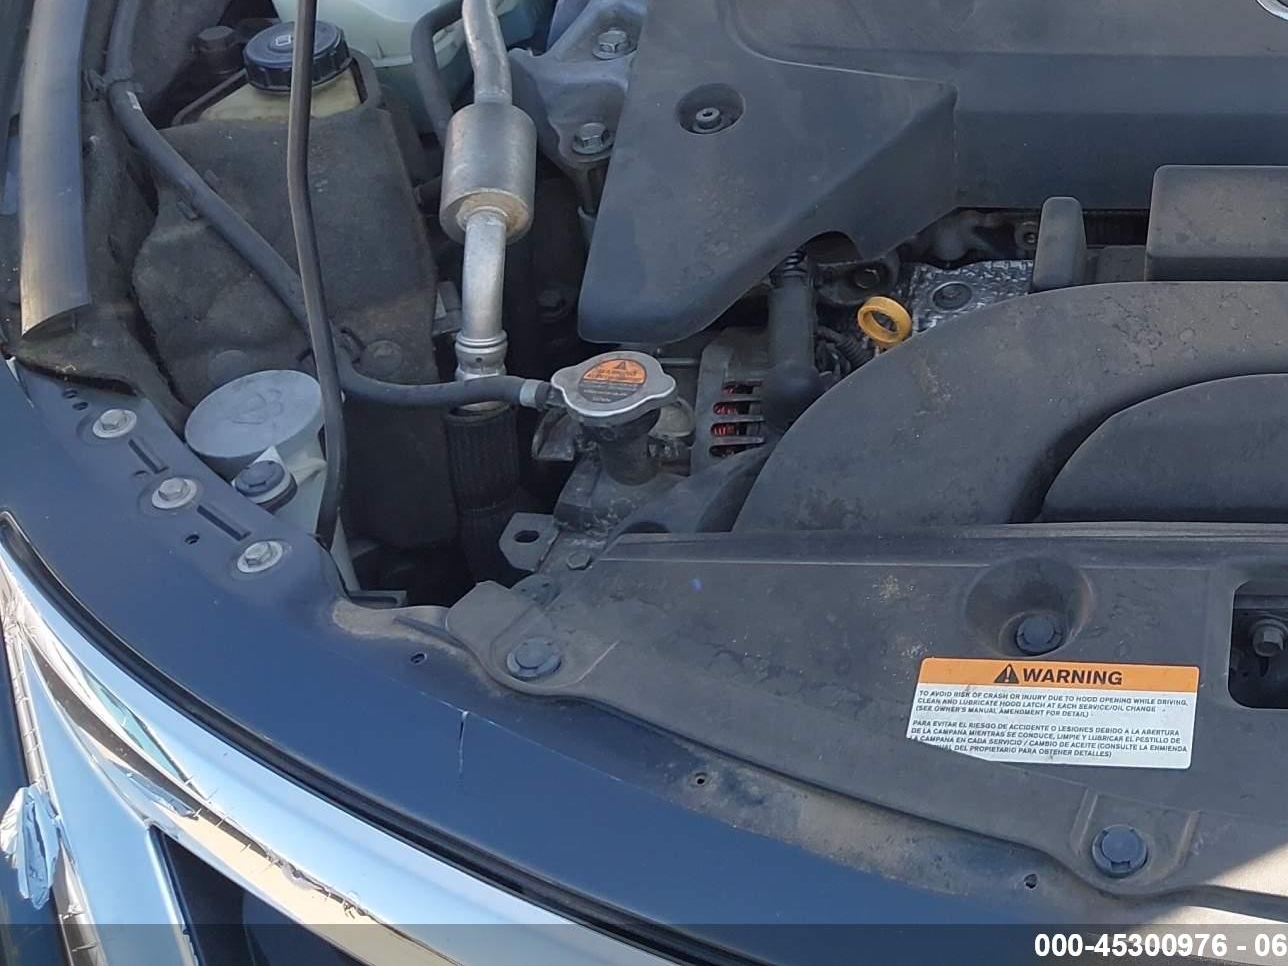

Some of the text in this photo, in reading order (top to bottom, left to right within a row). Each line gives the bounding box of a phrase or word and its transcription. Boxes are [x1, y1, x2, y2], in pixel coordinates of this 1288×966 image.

[1023, 667, 1123, 685] WARNING
[1100, 696, 1132, 704] OPENING
[968, 706, 997, 714] MANUAL
[912, 719, 931, 727] PARA
[1009, 723, 1049, 731] ACCIDENTE
[1058, 725, 1094, 733] LESIONES
[1056, 733, 1080, 741] LIMPIE
[1088, 734, 1123, 742] LUBRICAR
[1135, 736, 1169, 744] PESTILLO
[969, 745, 1017, 753] PROPIETARIO
[1039, 748, 1072, 756] OBTENER
[989, 738, 1022, 746] SERVICIO
[1150, 744, 1187, 752] ENMIENDA
